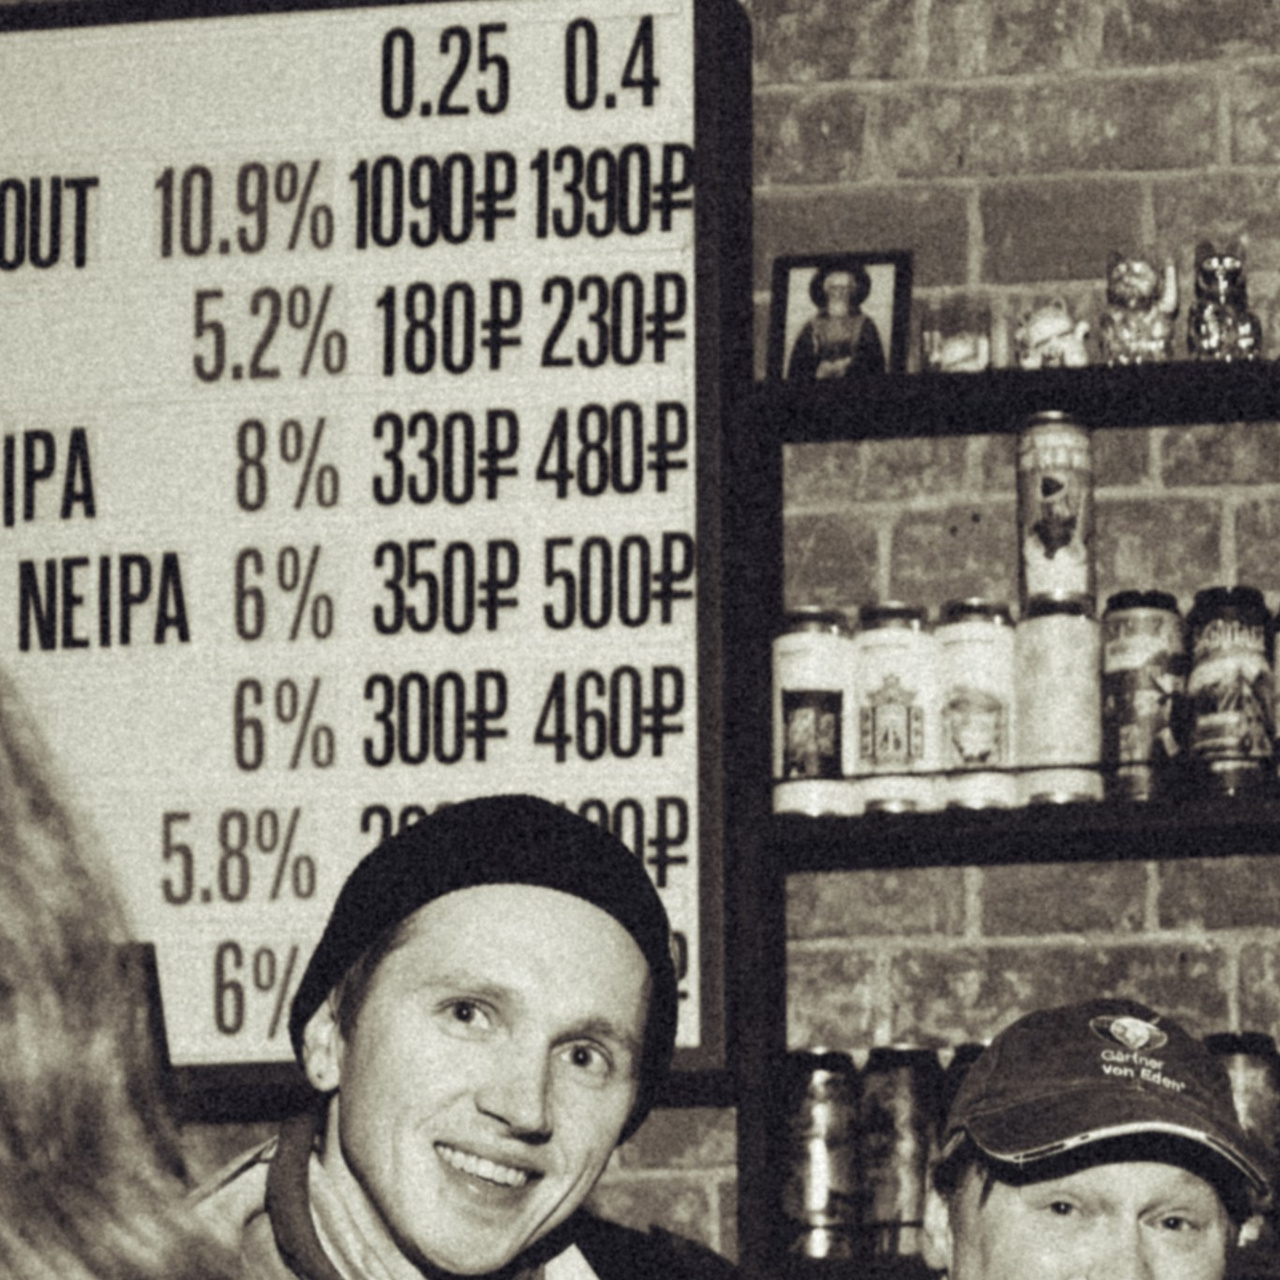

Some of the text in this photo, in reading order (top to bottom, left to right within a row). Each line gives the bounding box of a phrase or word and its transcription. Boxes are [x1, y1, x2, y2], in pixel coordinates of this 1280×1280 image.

[380, 13, 661, 121] 0.25 0.4
[0, 141, 695, 274] OUT 10.9% 1090₽ 1390₽
[192, 270, 688, 384] 5.2% 180₽ 230₽
[1, 399, 689, 529] IPA 8% 330₽ 480₽
[17, 531, 695, 654] NEIPA 6% 350₽ 500₽
[233, 664, 686, 773] 6% 300₽ 460₽
[161, 808, 316, 906] 5.8%
[1102, 1064, 1135, 1078] von
